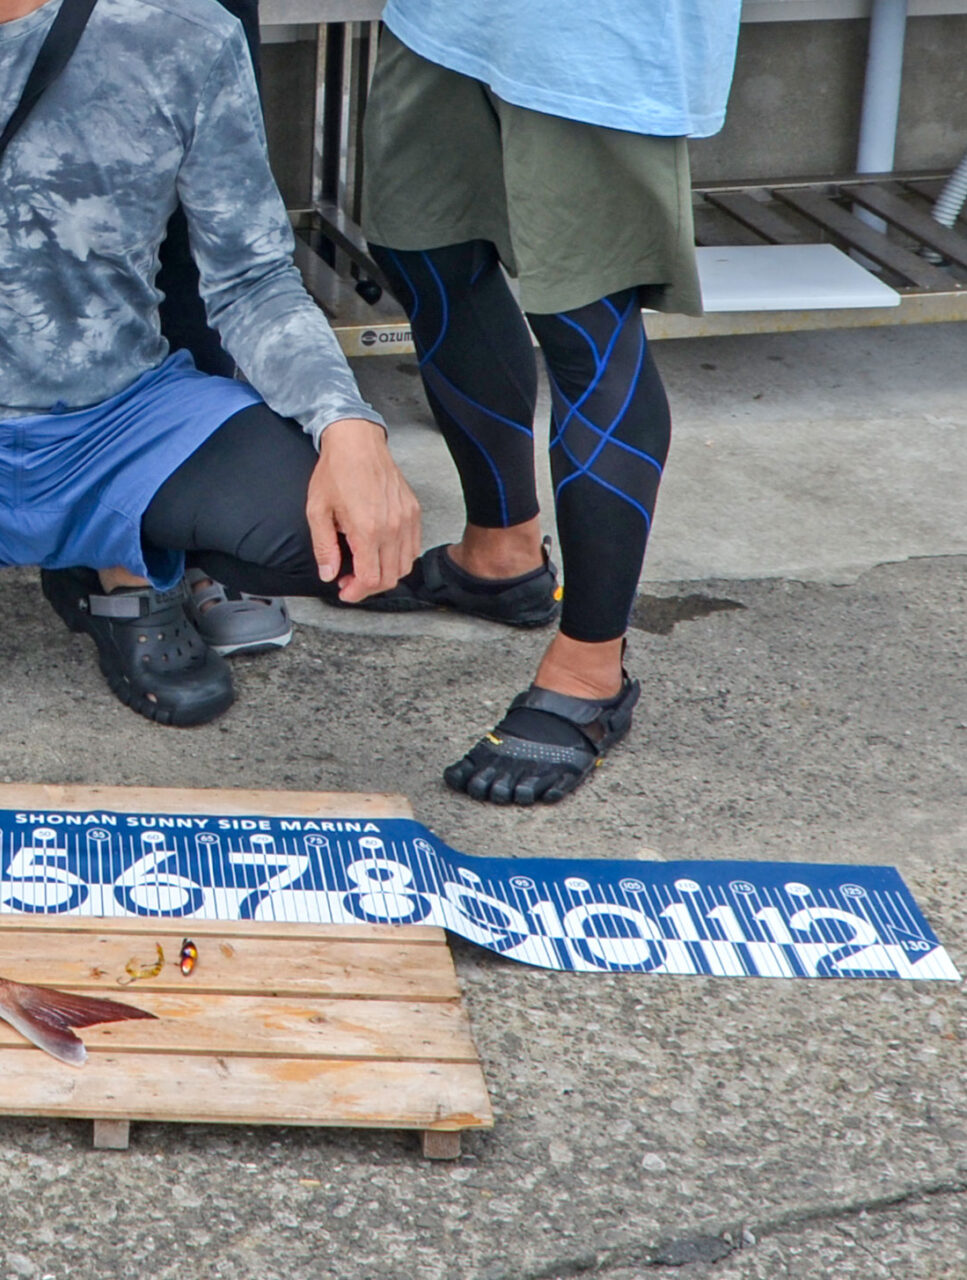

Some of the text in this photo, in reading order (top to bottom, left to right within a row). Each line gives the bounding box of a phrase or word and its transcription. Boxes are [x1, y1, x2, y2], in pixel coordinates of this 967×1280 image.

[15, 813, 381, 833] SHONAN SUNNY SIDE MARINA
[3, 847, 89, 914] 5
[113, 851, 206, 918] 6
[229, 852, 309, 920] 7
[343, 858, 432, 924] 8
[444, 881, 529, 953] 9
[527, 900, 668, 972] 10
[659, 903, 762, 977] 11
[753, 907, 901, 979] 12
[900, 939, 931, 952] 130
